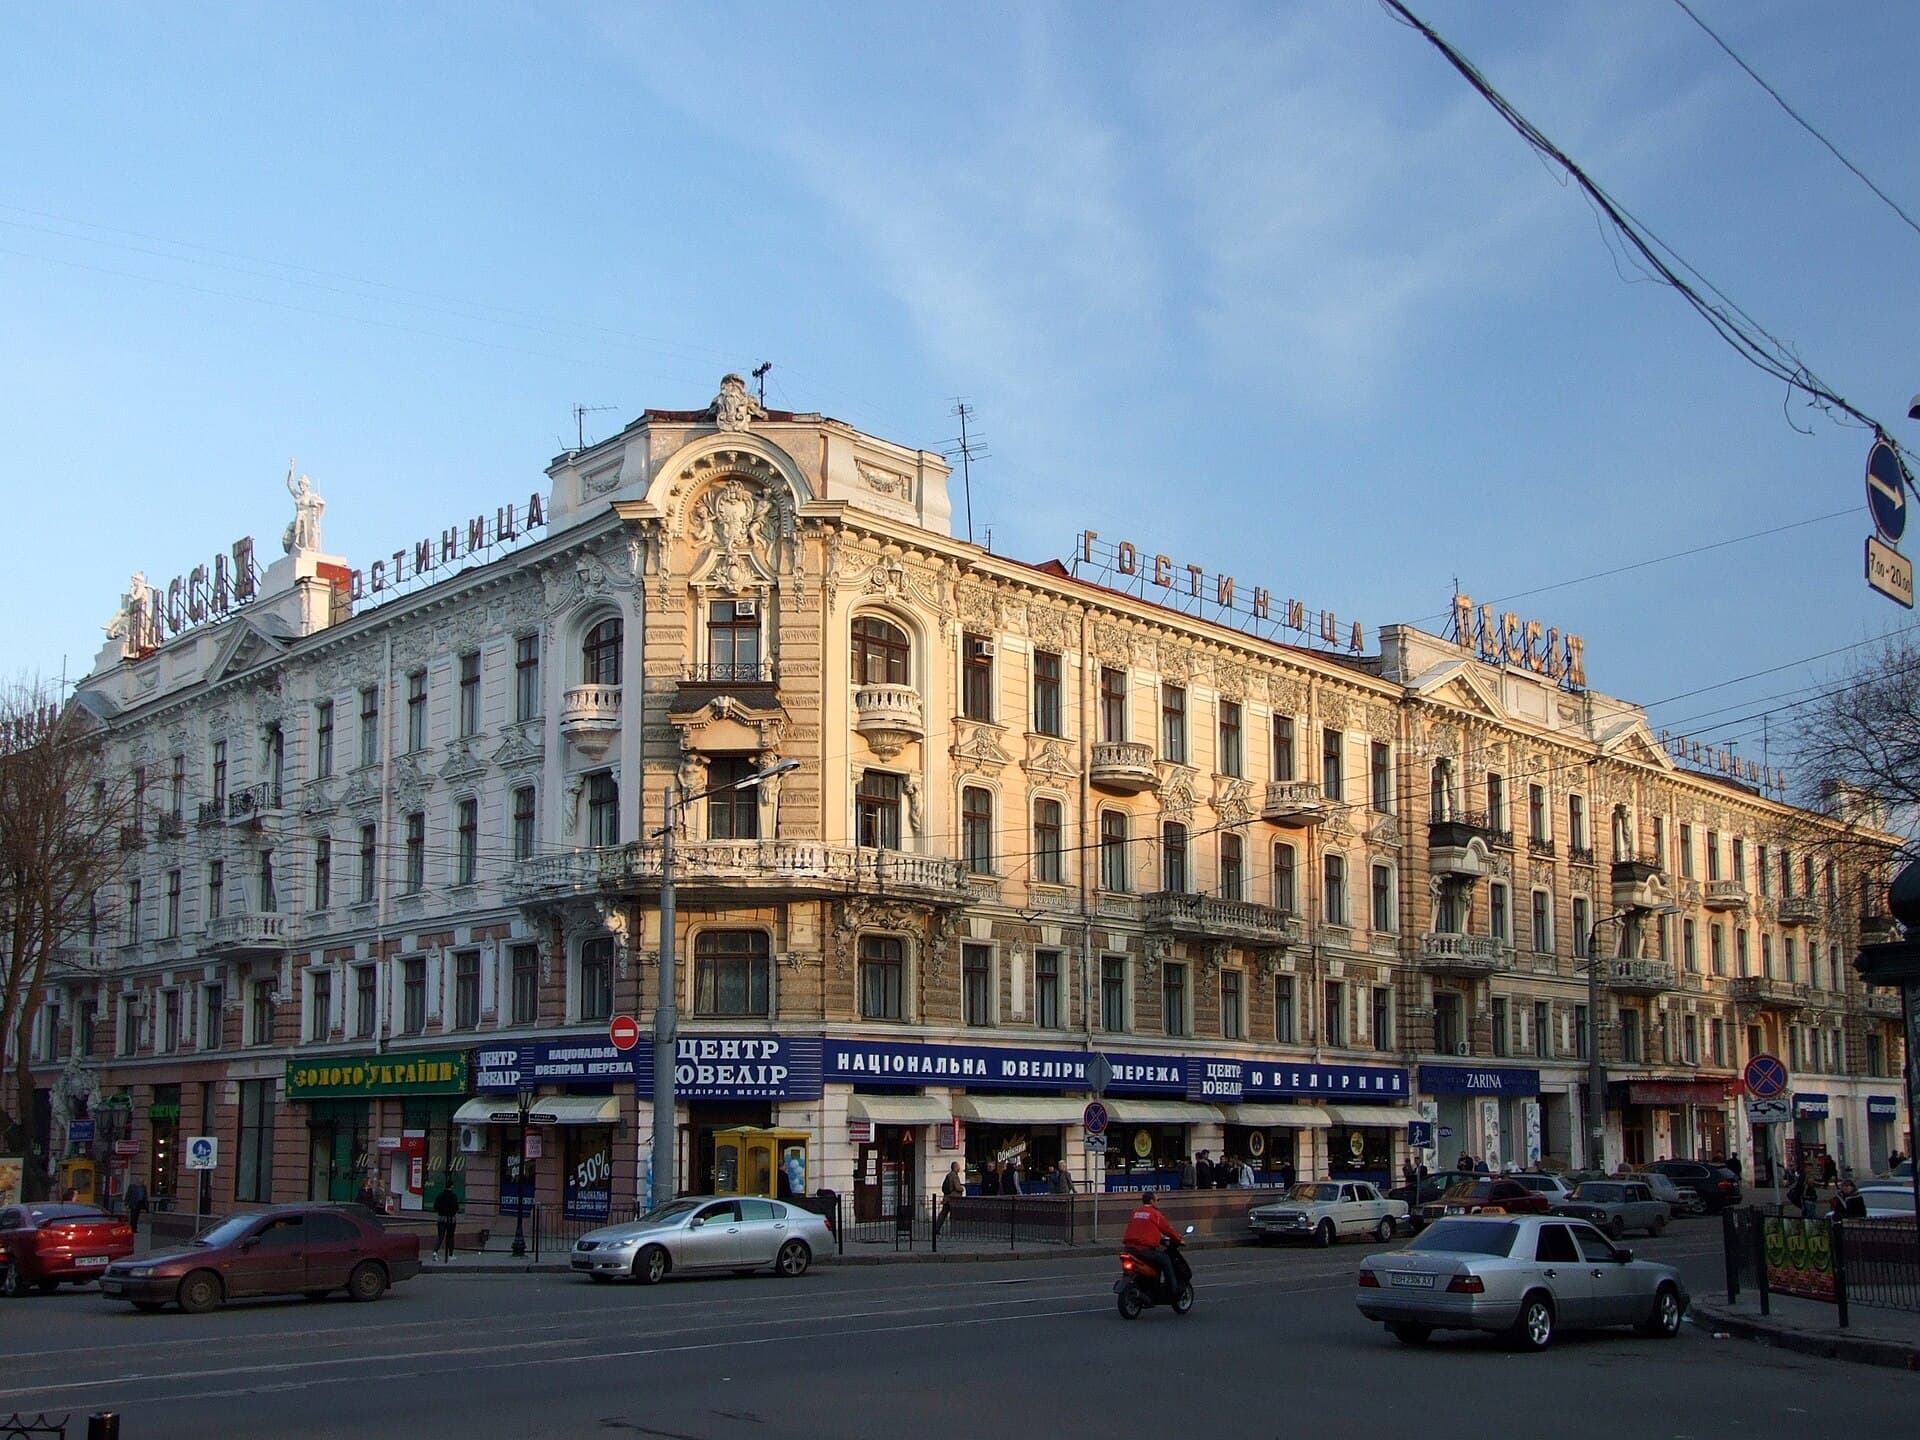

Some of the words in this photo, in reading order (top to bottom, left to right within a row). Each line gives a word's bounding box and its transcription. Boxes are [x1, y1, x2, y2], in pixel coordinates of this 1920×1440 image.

[1084, 529, 1363, 652] ГОСТИНИЦА
[1455, 594, 1586, 687] ПАССАЖ
[677, 1039, 779, 1064] ЦЕНТР
[368, 1059, 453, 1085] УКРАЇНИ
[587, 1062, 634, 1075] МЕРЕЖА
[837, 1052, 988, 1075] НАЦІОНАЛЬНА
[1002, 1060, 1085, 1079] ЮВЕЛІРН
[1112, 1063, 1180, 1083] МЕРЕЖА
[1207, 1063, 1242, 1082] ЦЕНТР
[1251, 1070, 1400, 1092] ЮВЕЛІРНИЙ
[1466, 1073, 1503, 1089] ZARINA
